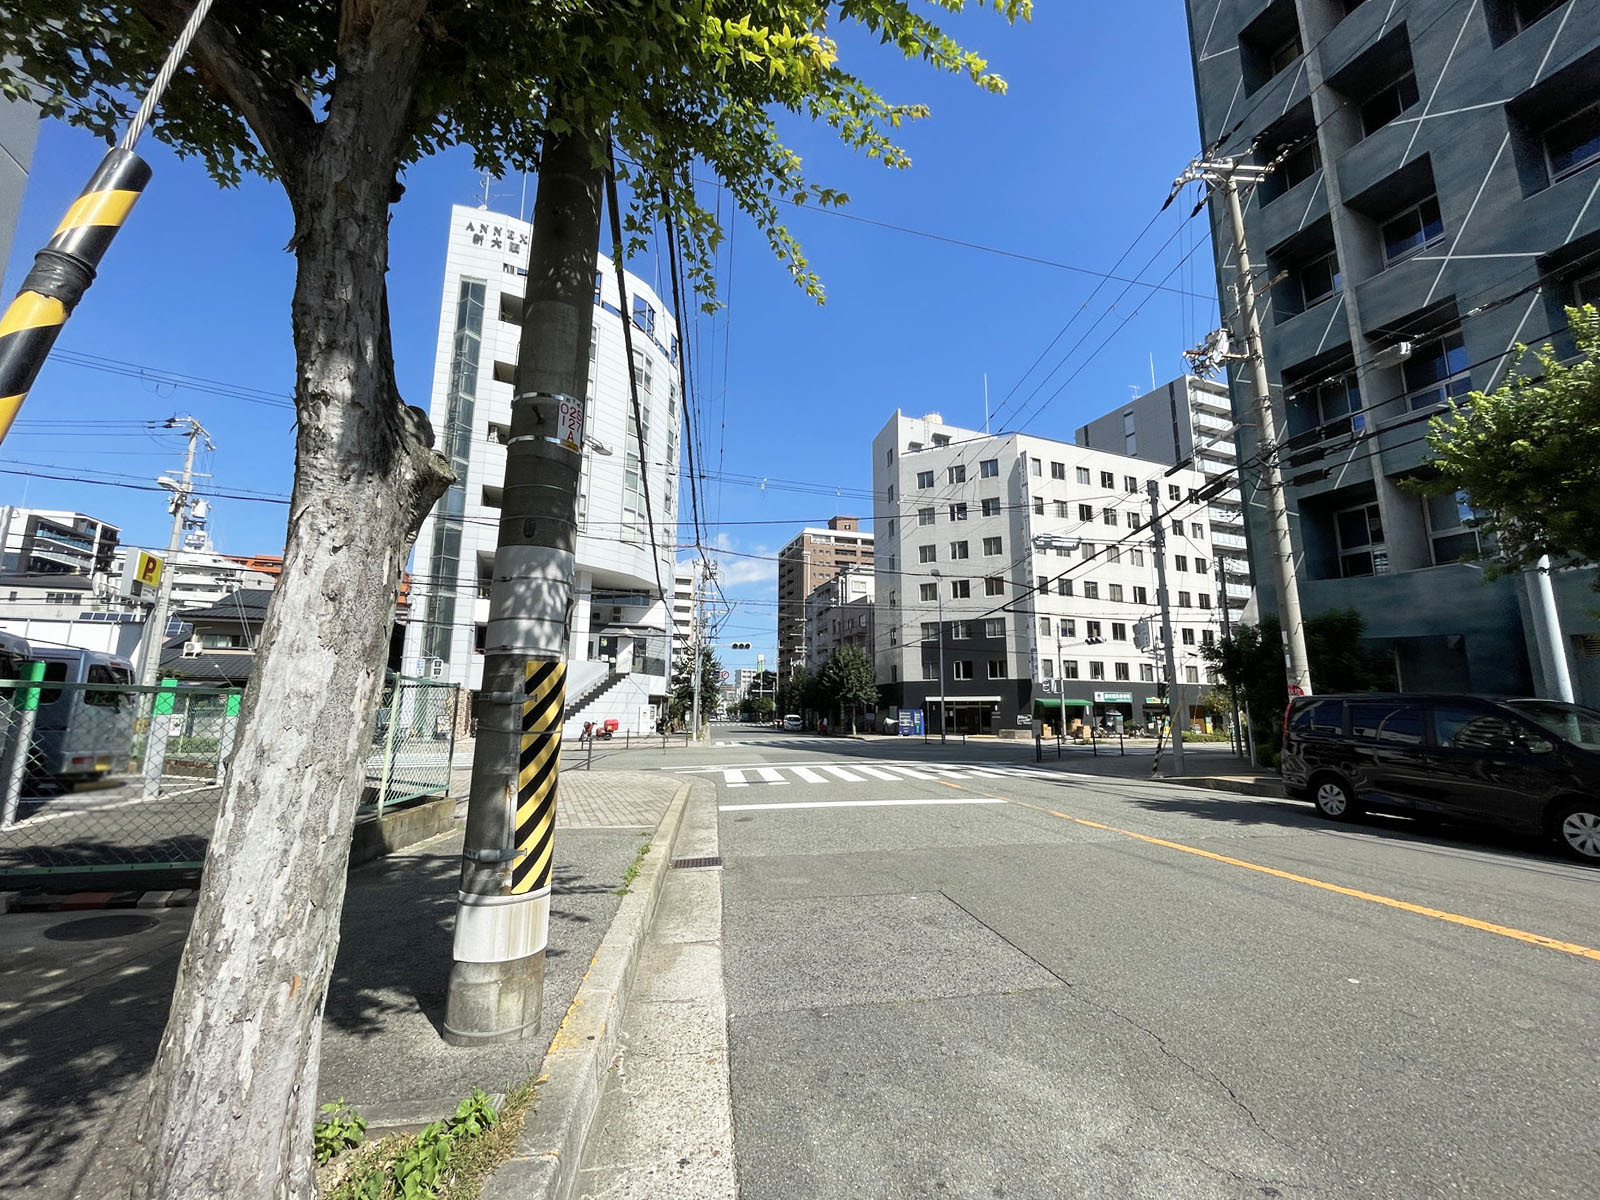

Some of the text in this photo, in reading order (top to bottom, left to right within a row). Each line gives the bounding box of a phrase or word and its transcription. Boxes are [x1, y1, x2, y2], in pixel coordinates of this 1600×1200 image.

[465, 221, 528, 245] ANNEX
[567, 431, 574, 442] A
[141, 556, 157, 580] P
